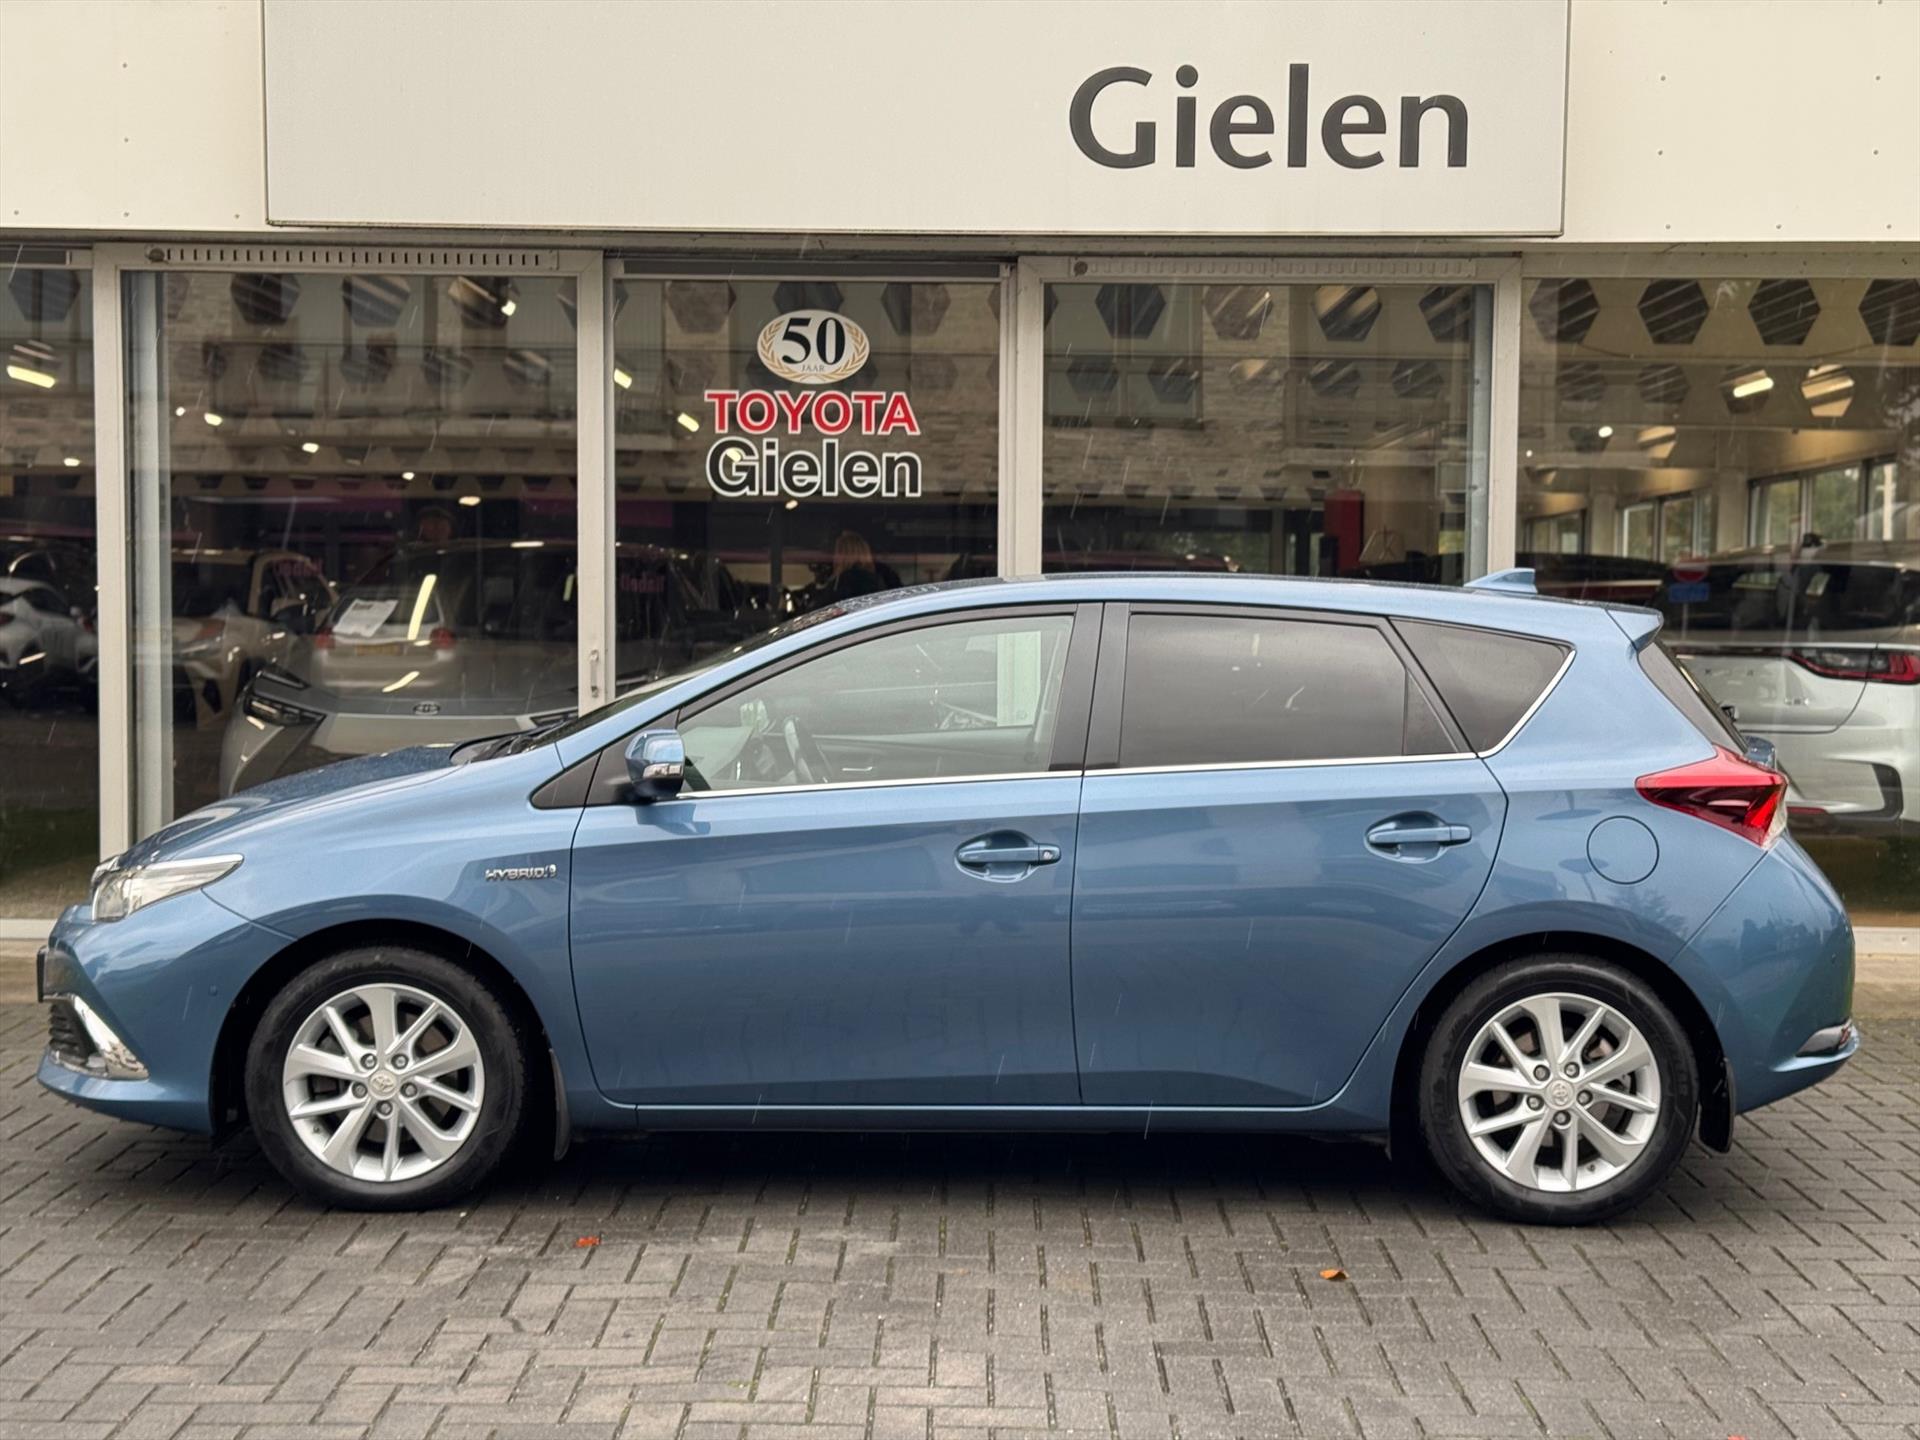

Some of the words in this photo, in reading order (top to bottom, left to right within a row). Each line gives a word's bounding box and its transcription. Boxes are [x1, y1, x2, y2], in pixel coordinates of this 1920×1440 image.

[1069, 63, 1468, 169] Gielen
[782, 317, 846, 364] 50
[801, 364, 825, 372] JAAR
[704, 390, 921, 435] TOYOTA
[706, 436, 922, 498] Gielen
[485, 867, 545, 880] HYBRID
